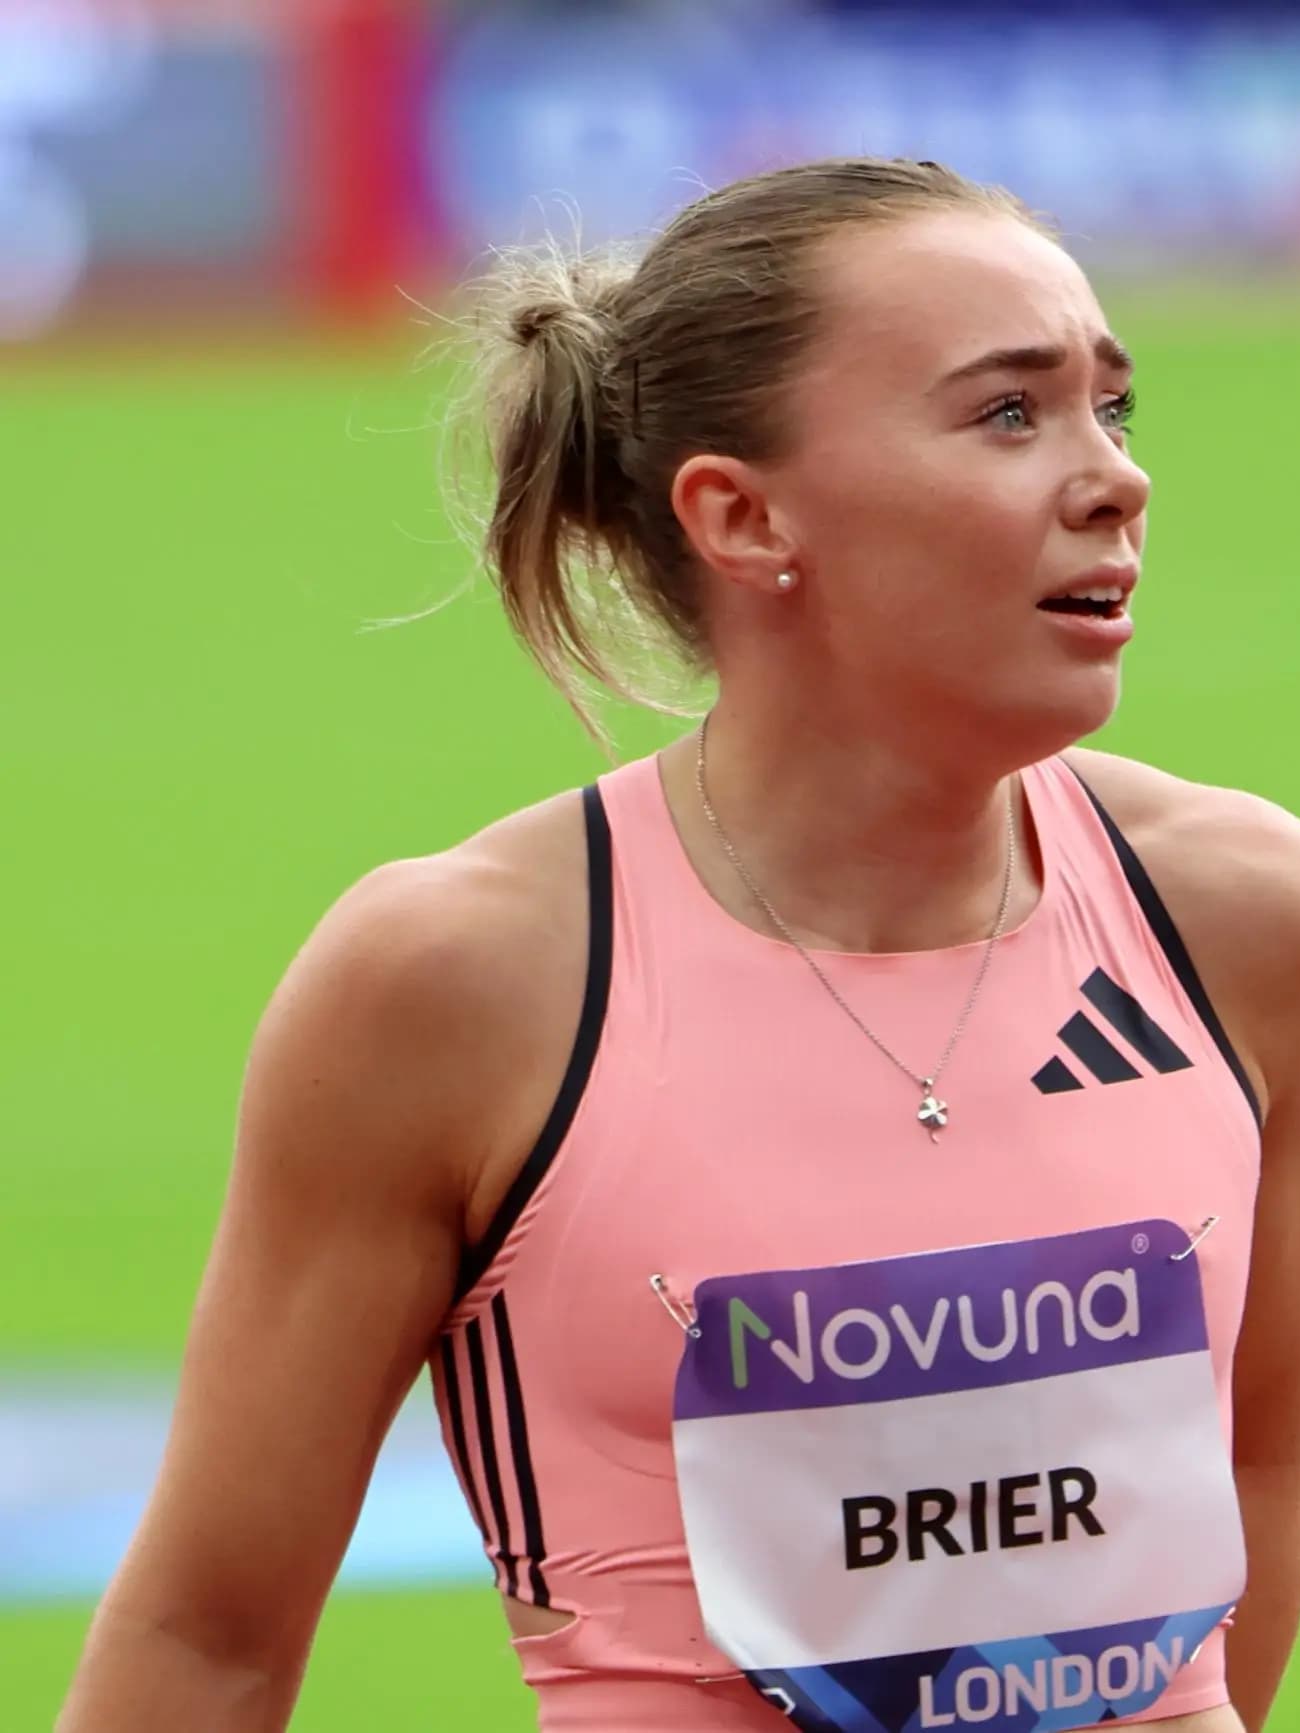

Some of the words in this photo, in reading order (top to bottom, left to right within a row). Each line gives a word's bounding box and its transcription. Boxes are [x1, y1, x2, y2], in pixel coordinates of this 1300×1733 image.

[729, 1267, 1140, 1389] Novuna
[841, 1466, 1107, 1571] BRIER
[918, 1636, 1185, 1729] LONDON
